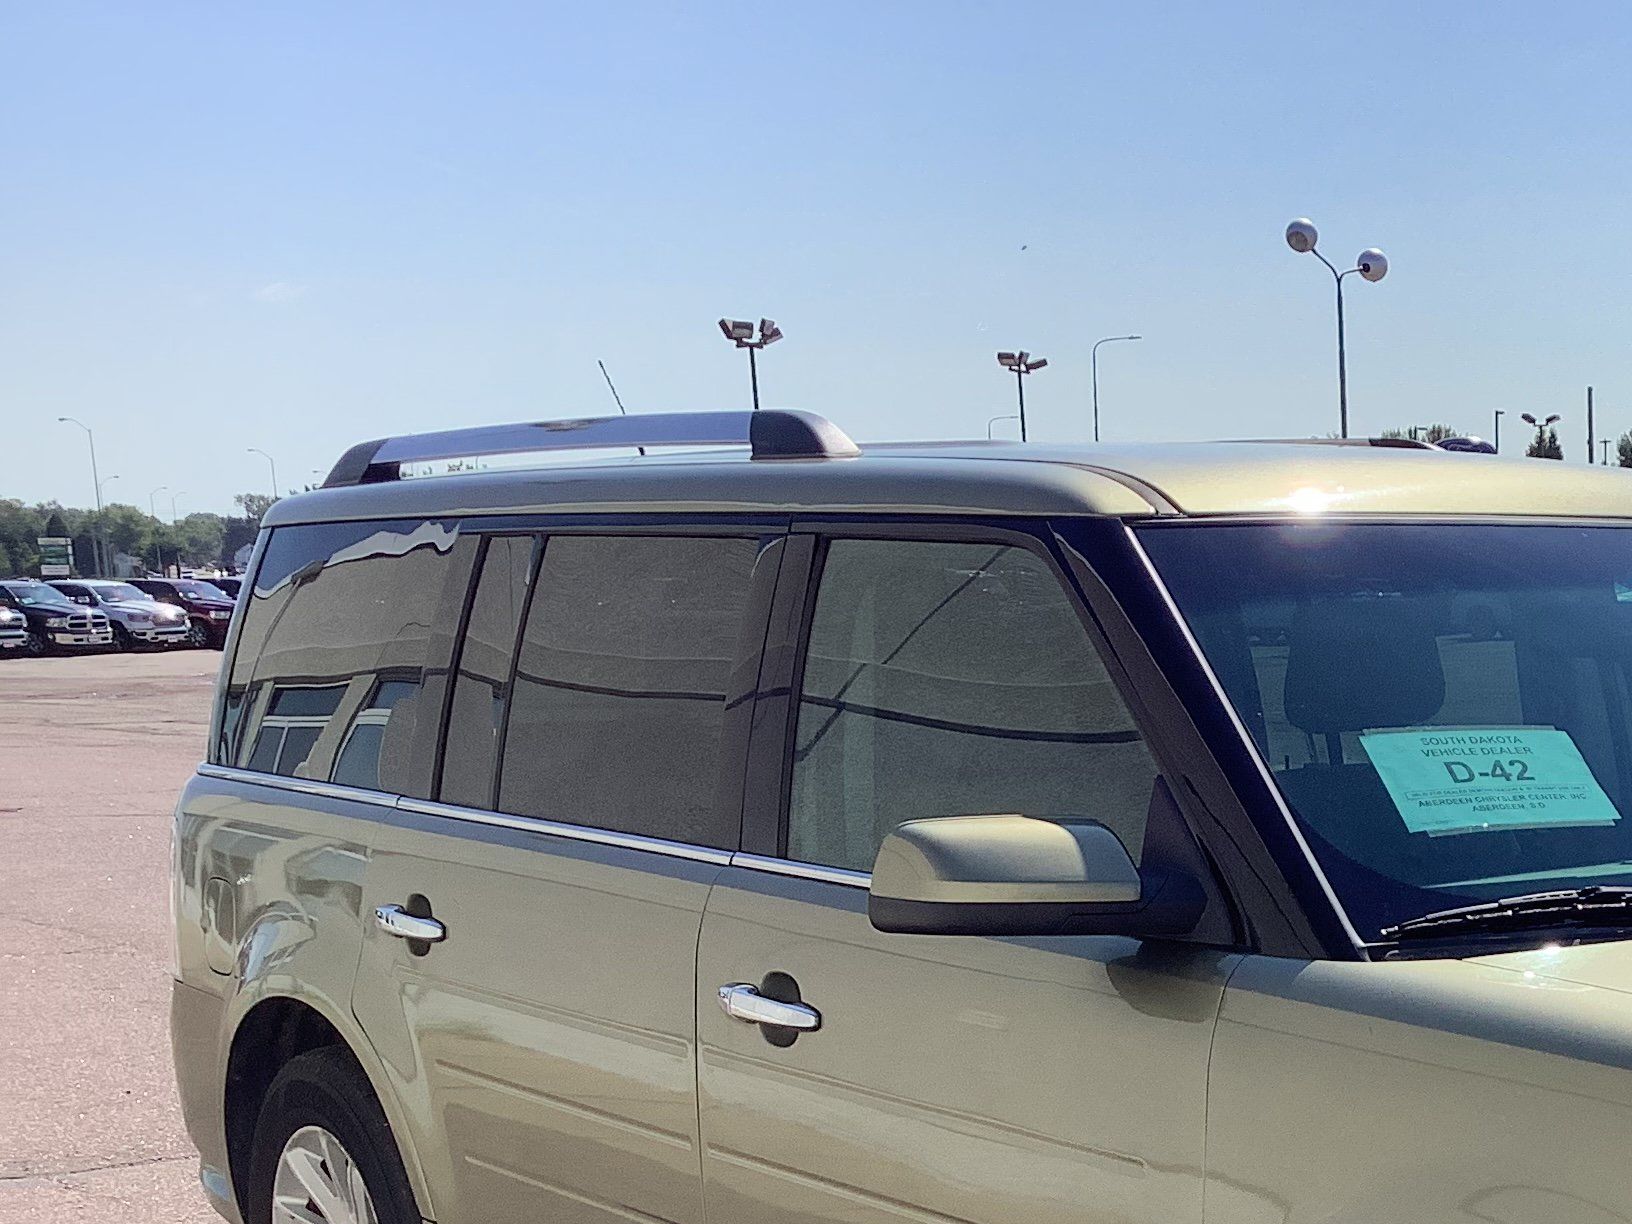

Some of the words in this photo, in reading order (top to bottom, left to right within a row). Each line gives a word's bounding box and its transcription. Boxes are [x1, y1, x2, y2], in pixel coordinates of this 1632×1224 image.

[1420, 736, 1467, 746] SOUTH
[1468, 735, 1523, 744] DAKOTA
[1421, 747, 1479, 757] VEHICLE
[1480, 747, 1534, 756] DEALER
[1443, 759, 1536, 784] D-42
[1418, 797, 1473, 807] ABERDEEN
[1473, 794, 1526, 803] CHRYSLER
